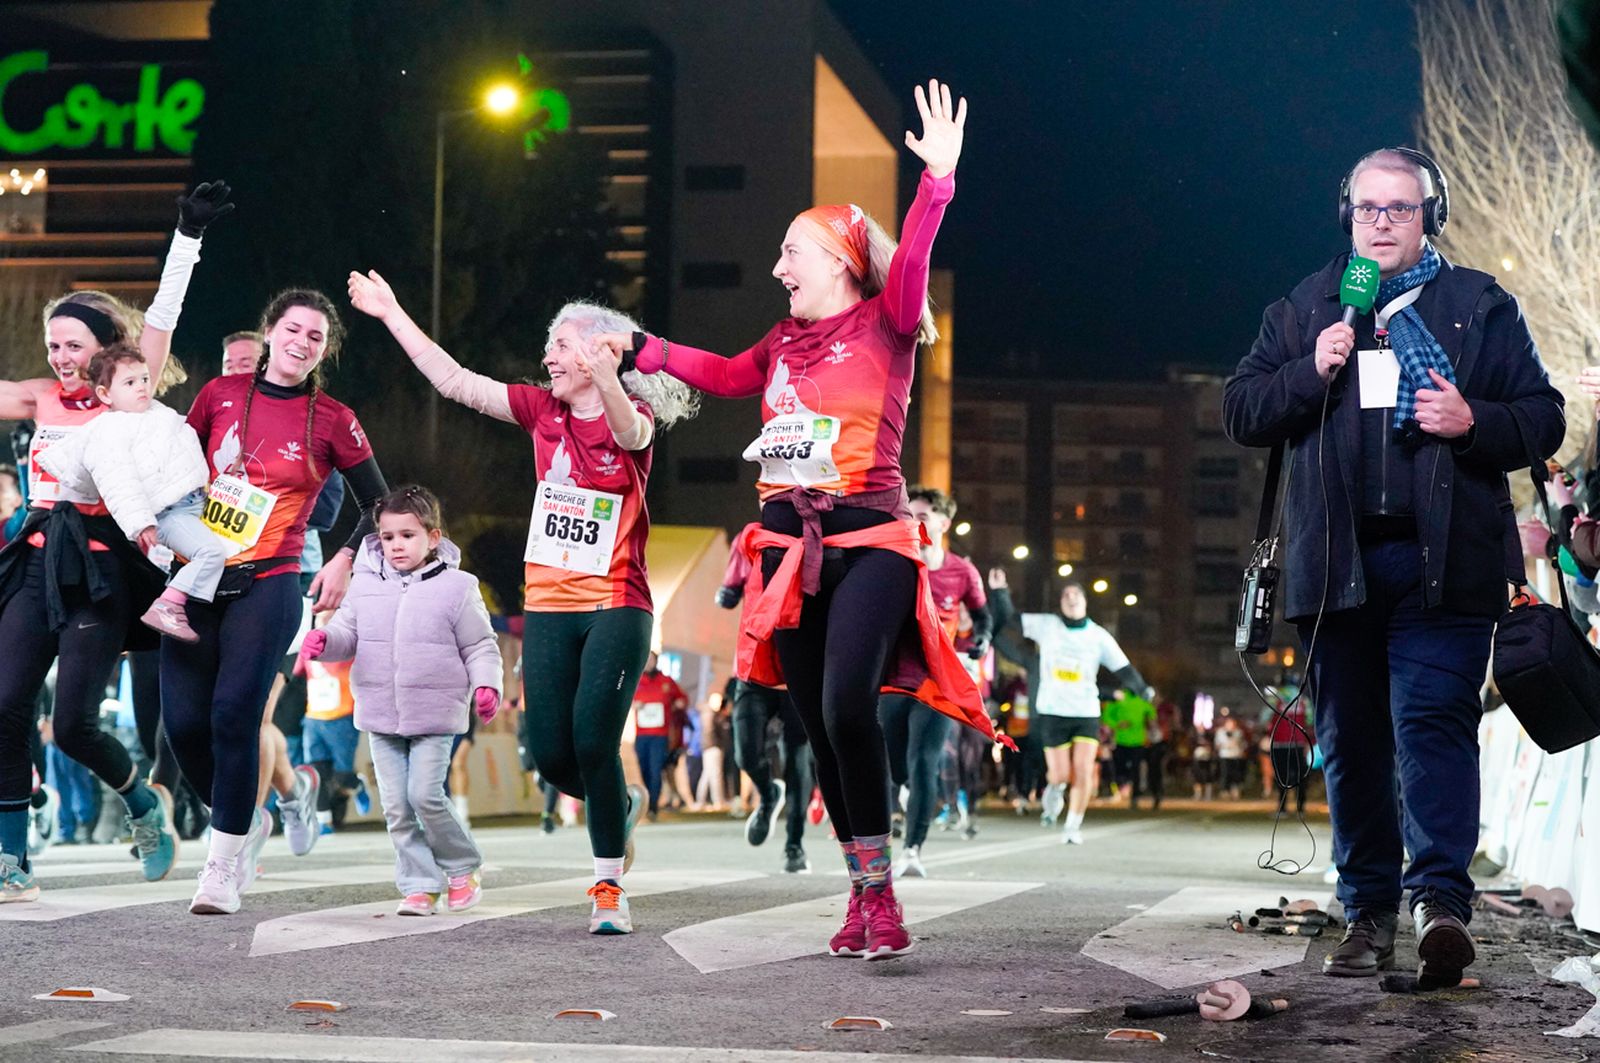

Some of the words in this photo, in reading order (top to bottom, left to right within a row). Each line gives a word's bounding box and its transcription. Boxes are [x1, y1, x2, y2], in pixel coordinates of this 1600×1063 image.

[0, 50, 206, 154] Corte
[775, 392, 796, 414] 43
[214, 480, 233, 493] OCHE
[543, 501, 558, 511] SAN
[553, 493, 576, 504] NOCHE
[576, 498, 586, 506] DE
[545, 513, 600, 545] 6353
